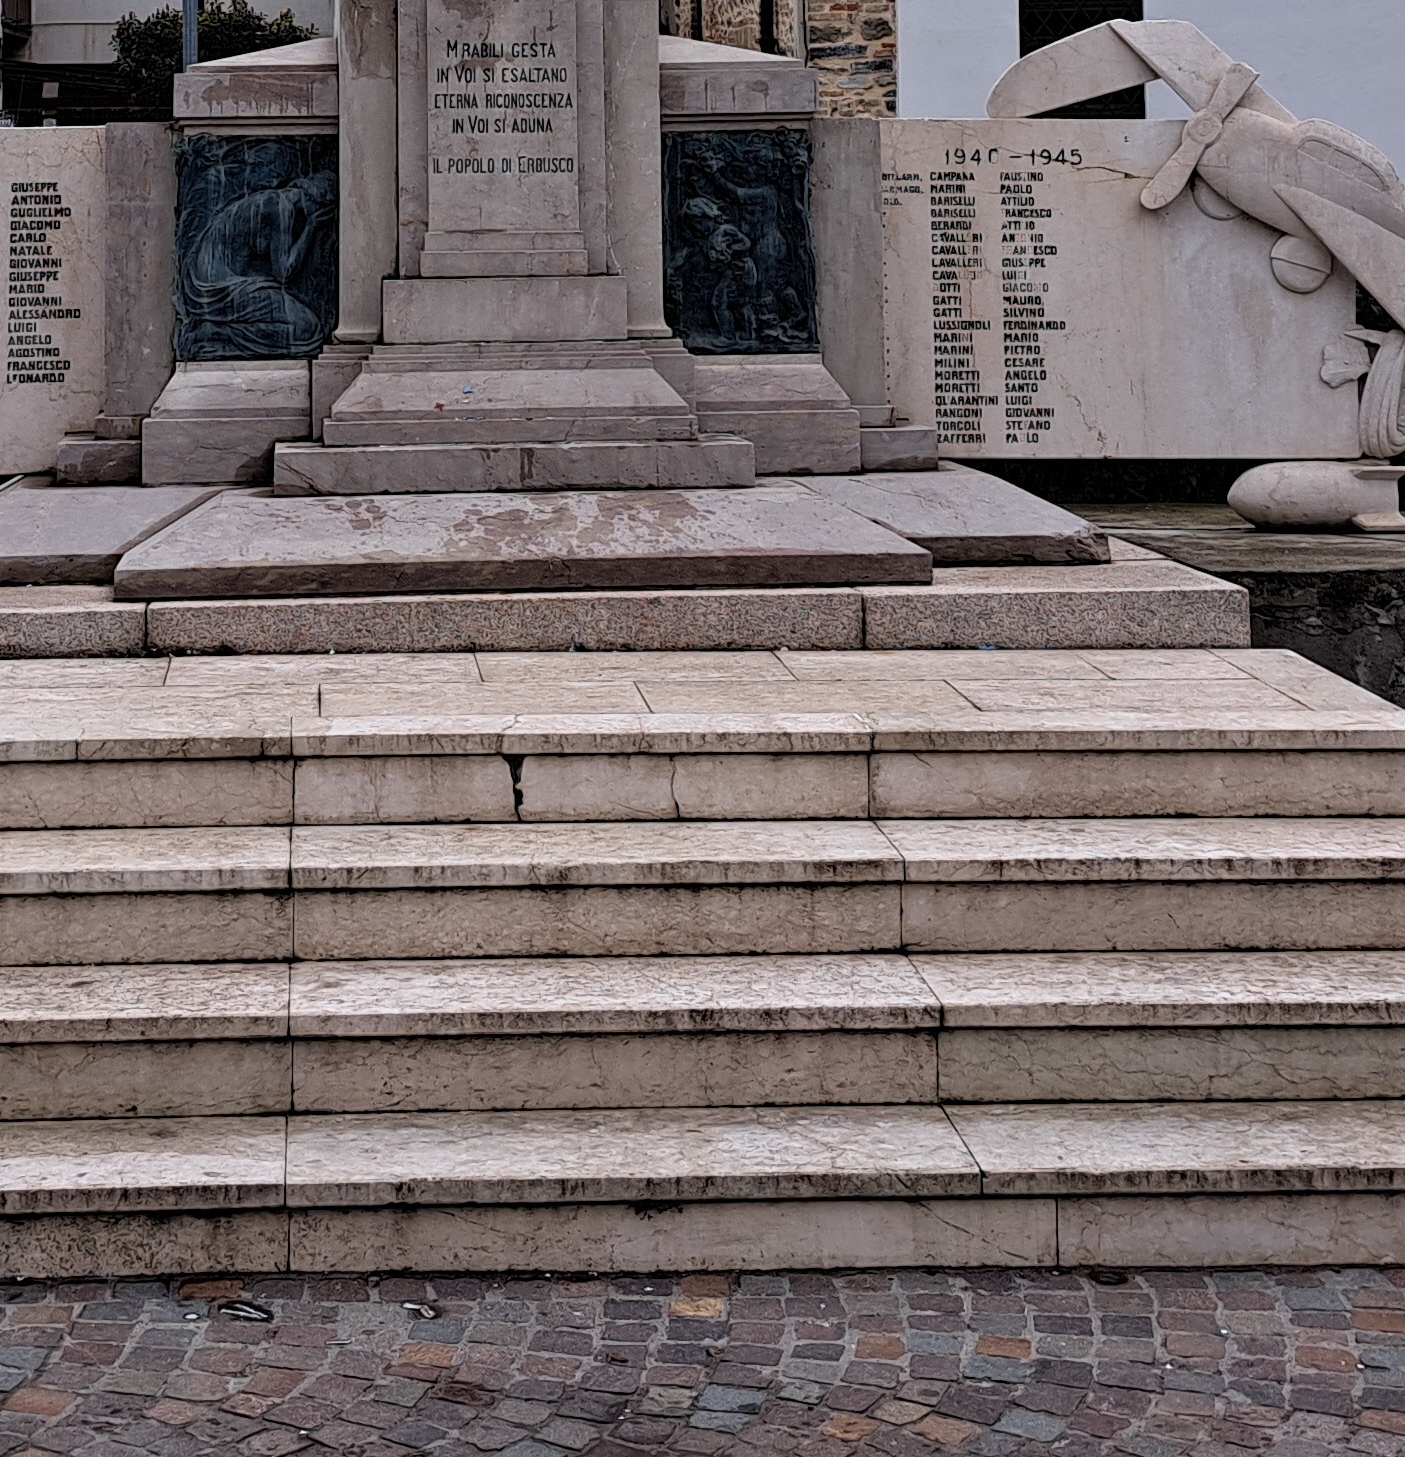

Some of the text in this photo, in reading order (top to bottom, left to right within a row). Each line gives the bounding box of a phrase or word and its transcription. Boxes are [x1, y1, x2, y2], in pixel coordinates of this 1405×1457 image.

[447, 40, 555, 58] MRABILI GESTA
[437, 68, 449, 83] IN
[483, 68, 494, 83] SI
[502, 68, 566, 83] ESALTANO
[435, 93, 573, 109] ETERNA RICONOSCENZA
[453, 118, 463, 133] IN
[494, 118, 505, 133] SI
[512, 118, 553, 133] ADUNA
[946, 148, 999, 166] 1940
[1031, 148, 1082, 165] 1945
[433, 156, 574, 173] IL POPOLO DI ERBUSCO
[930, 172, 975, 181] CAMPANA
[11, 183, 58, 192] GIUSEPPE
[1000, 185, 1032, 194] PAOLO
[12, 195, 61, 205] ANTONIO
[11, 207, 71, 218] GUGLIELMO
[11, 221, 60, 230] GIACOMO
[10, 233, 46, 243] CARLO
[10, 246, 52, 256] NATALE
[9, 258, 62, 269] GIOVANNI
[9, 271, 59, 282] GIUSEPPE
[9, 284, 44, 294] MARIO
[9, 296, 61, 307] GIOVANNI
[933, 296, 961, 306] GATTI
[8, 309, 81, 319] ALESSANDRO
[933, 308, 1044, 318] GATTI SILVINO
[8, 322, 36, 333] LUIGI
[8, 335, 51, 346] ANGELO
[1004, 333, 1038, 342] MARIO
[8, 348, 59, 358] AGOSTINO
[934, 345, 1040, 355] MARINI PIETRO
[8, 361, 70, 371] FRANCESCO
[935, 358, 1045, 368] MILINI CESARE
[935, 370, 1046, 381] MORETTI ANGELO
[935, 383, 1038, 393] MORETTI SANTO
[1006, 396, 1032, 405] LUIGI
[936, 408, 1054, 418] RANGONI GIOVANNI
